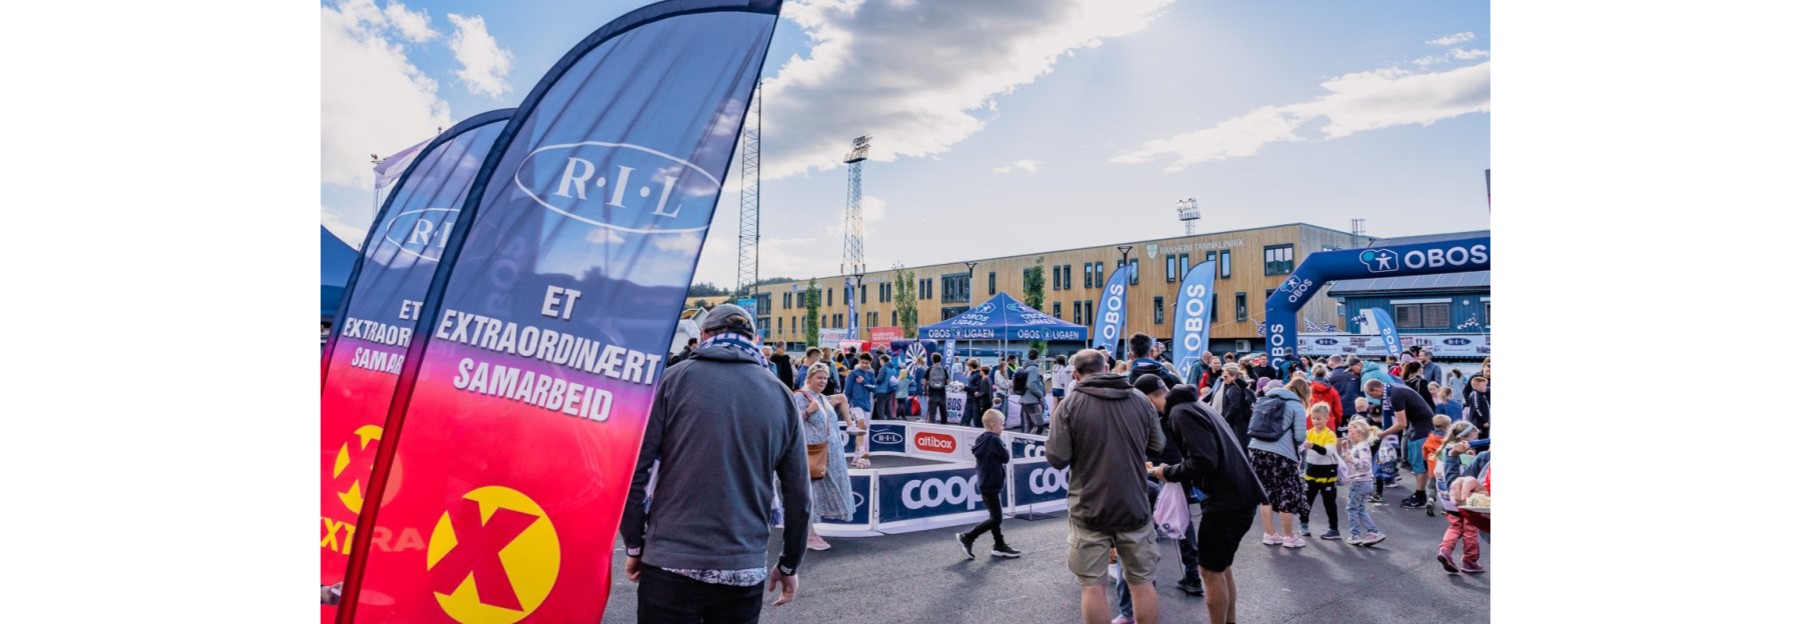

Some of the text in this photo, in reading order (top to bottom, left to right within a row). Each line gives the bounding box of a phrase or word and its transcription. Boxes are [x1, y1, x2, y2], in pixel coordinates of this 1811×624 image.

[1404, 244, 1489, 269] OBOS
[541, 284, 581, 321] ET
[1288, 278, 1313, 303] OBOS
[399, 299, 424, 321] ET
[961, 313, 990, 322] OBOS
[1103, 283, 1124, 340] OBOS
[1184, 284, 1206, 352] OBOS
[342, 317, 413, 348] EXTRAOR
[928, 329, 995, 338] OBOS LIGAEN
[1017, 329, 1080, 340] OBOS LIGAEN
[351, 346, 405, 375] SAMAR
[435, 308, 662, 386] EXTRAORDINÆRT
[1271, 323, 1285, 374] OBOS
[453, 357, 613, 423] SAMARBEID
[947, 397, 962, 411] BOS
[918, 436, 953, 449] altibox
